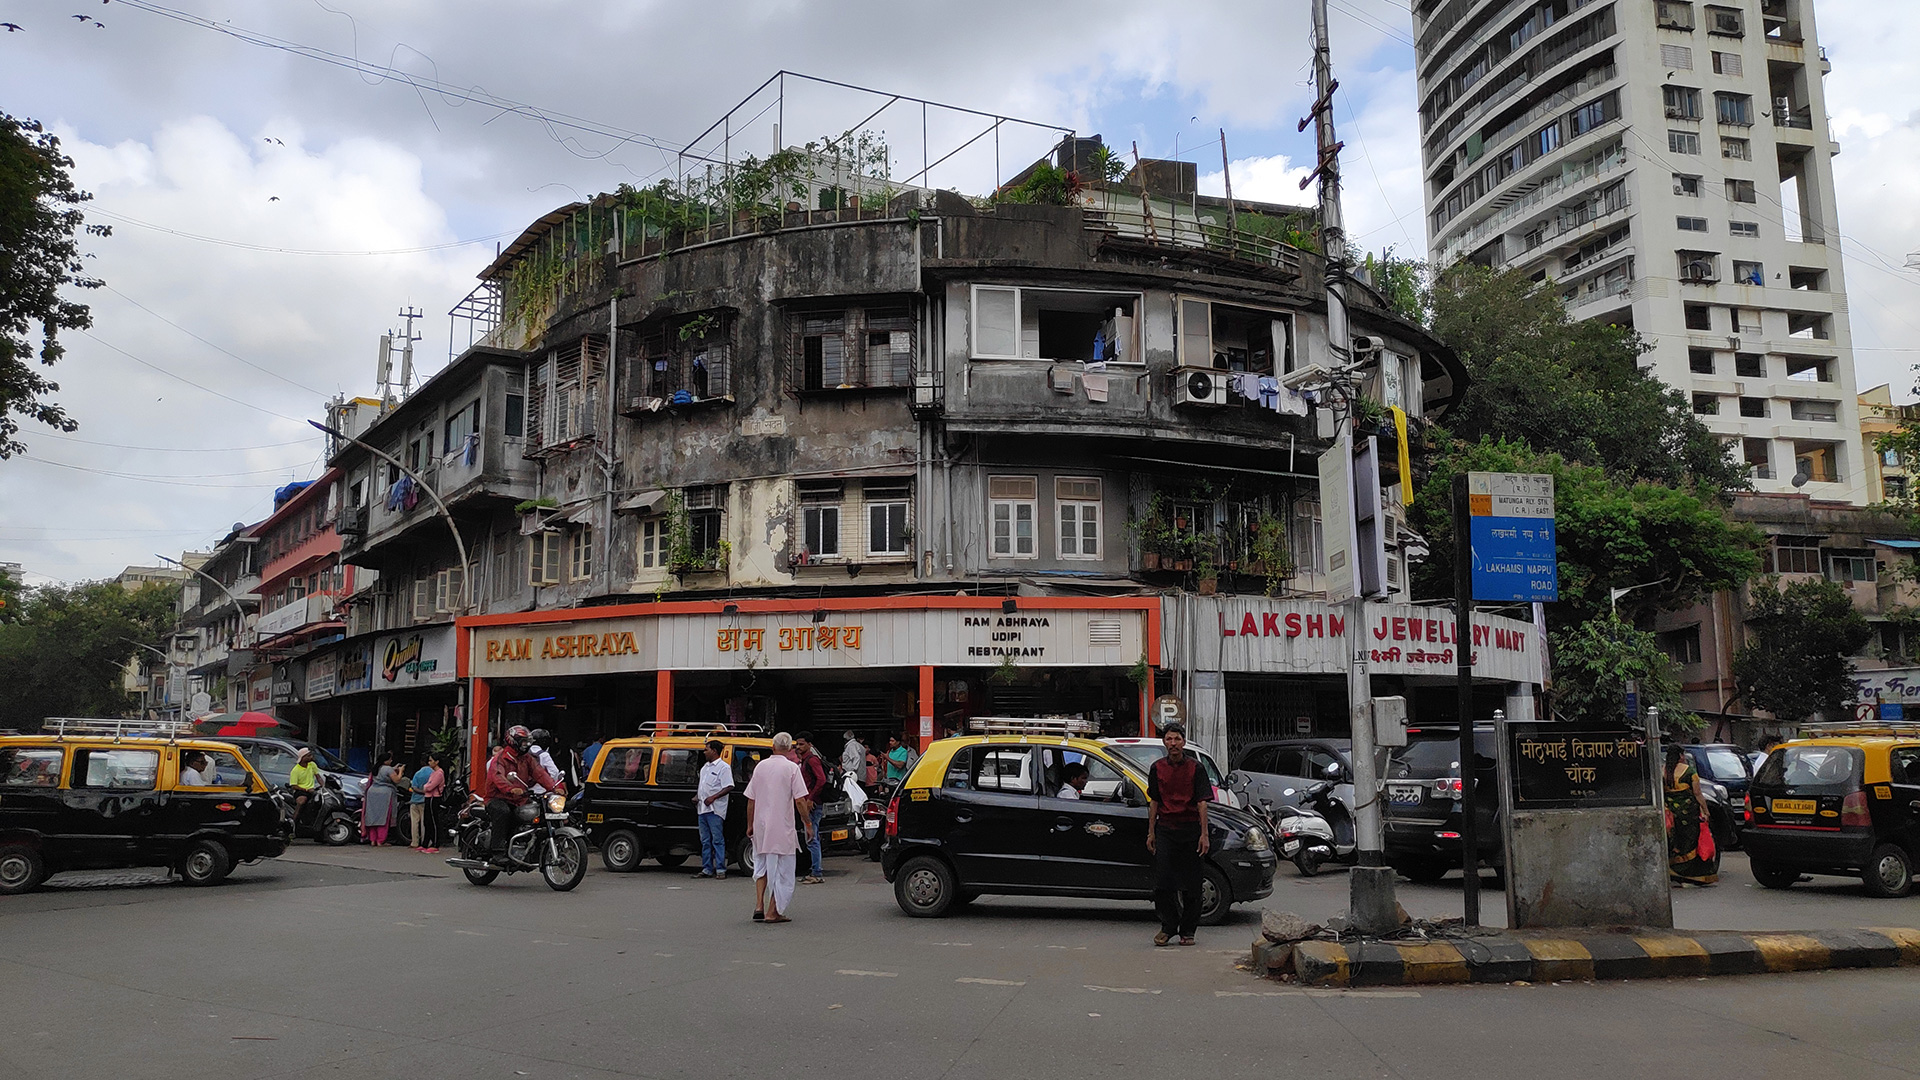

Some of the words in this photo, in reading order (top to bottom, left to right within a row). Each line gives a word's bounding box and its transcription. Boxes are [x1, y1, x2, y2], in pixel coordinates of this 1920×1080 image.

[1498, 497, 1524, 505] MATUNGA
[1535, 507, 1550, 515] EAST
[1485, 563, 1524, 574] LAKHAMSI
[1527, 565, 1552, 575] NAPPU
[1531, 580, 1553, 590] ROAD
[964, 617, 990, 627] RAM
[997, 617, 1050, 627] ASHRAYA
[992, 632, 1021, 641] UDIPI
[1219, 612, 1345, 638] LAKSHM
[1373, 617, 1490, 647] JEWELLRY
[1495, 627, 1525, 653] MART
[717, 628, 765, 651] राम
[778, 626, 863, 651] आश्रय
[486, 638, 533, 661] RAM
[541, 631, 639, 659] ASHRAYA
[968, 646, 1045, 656] RESTAURANT
[1359, 666, 1365, 675] 3
[1563, 763, 1597, 783] चौक
